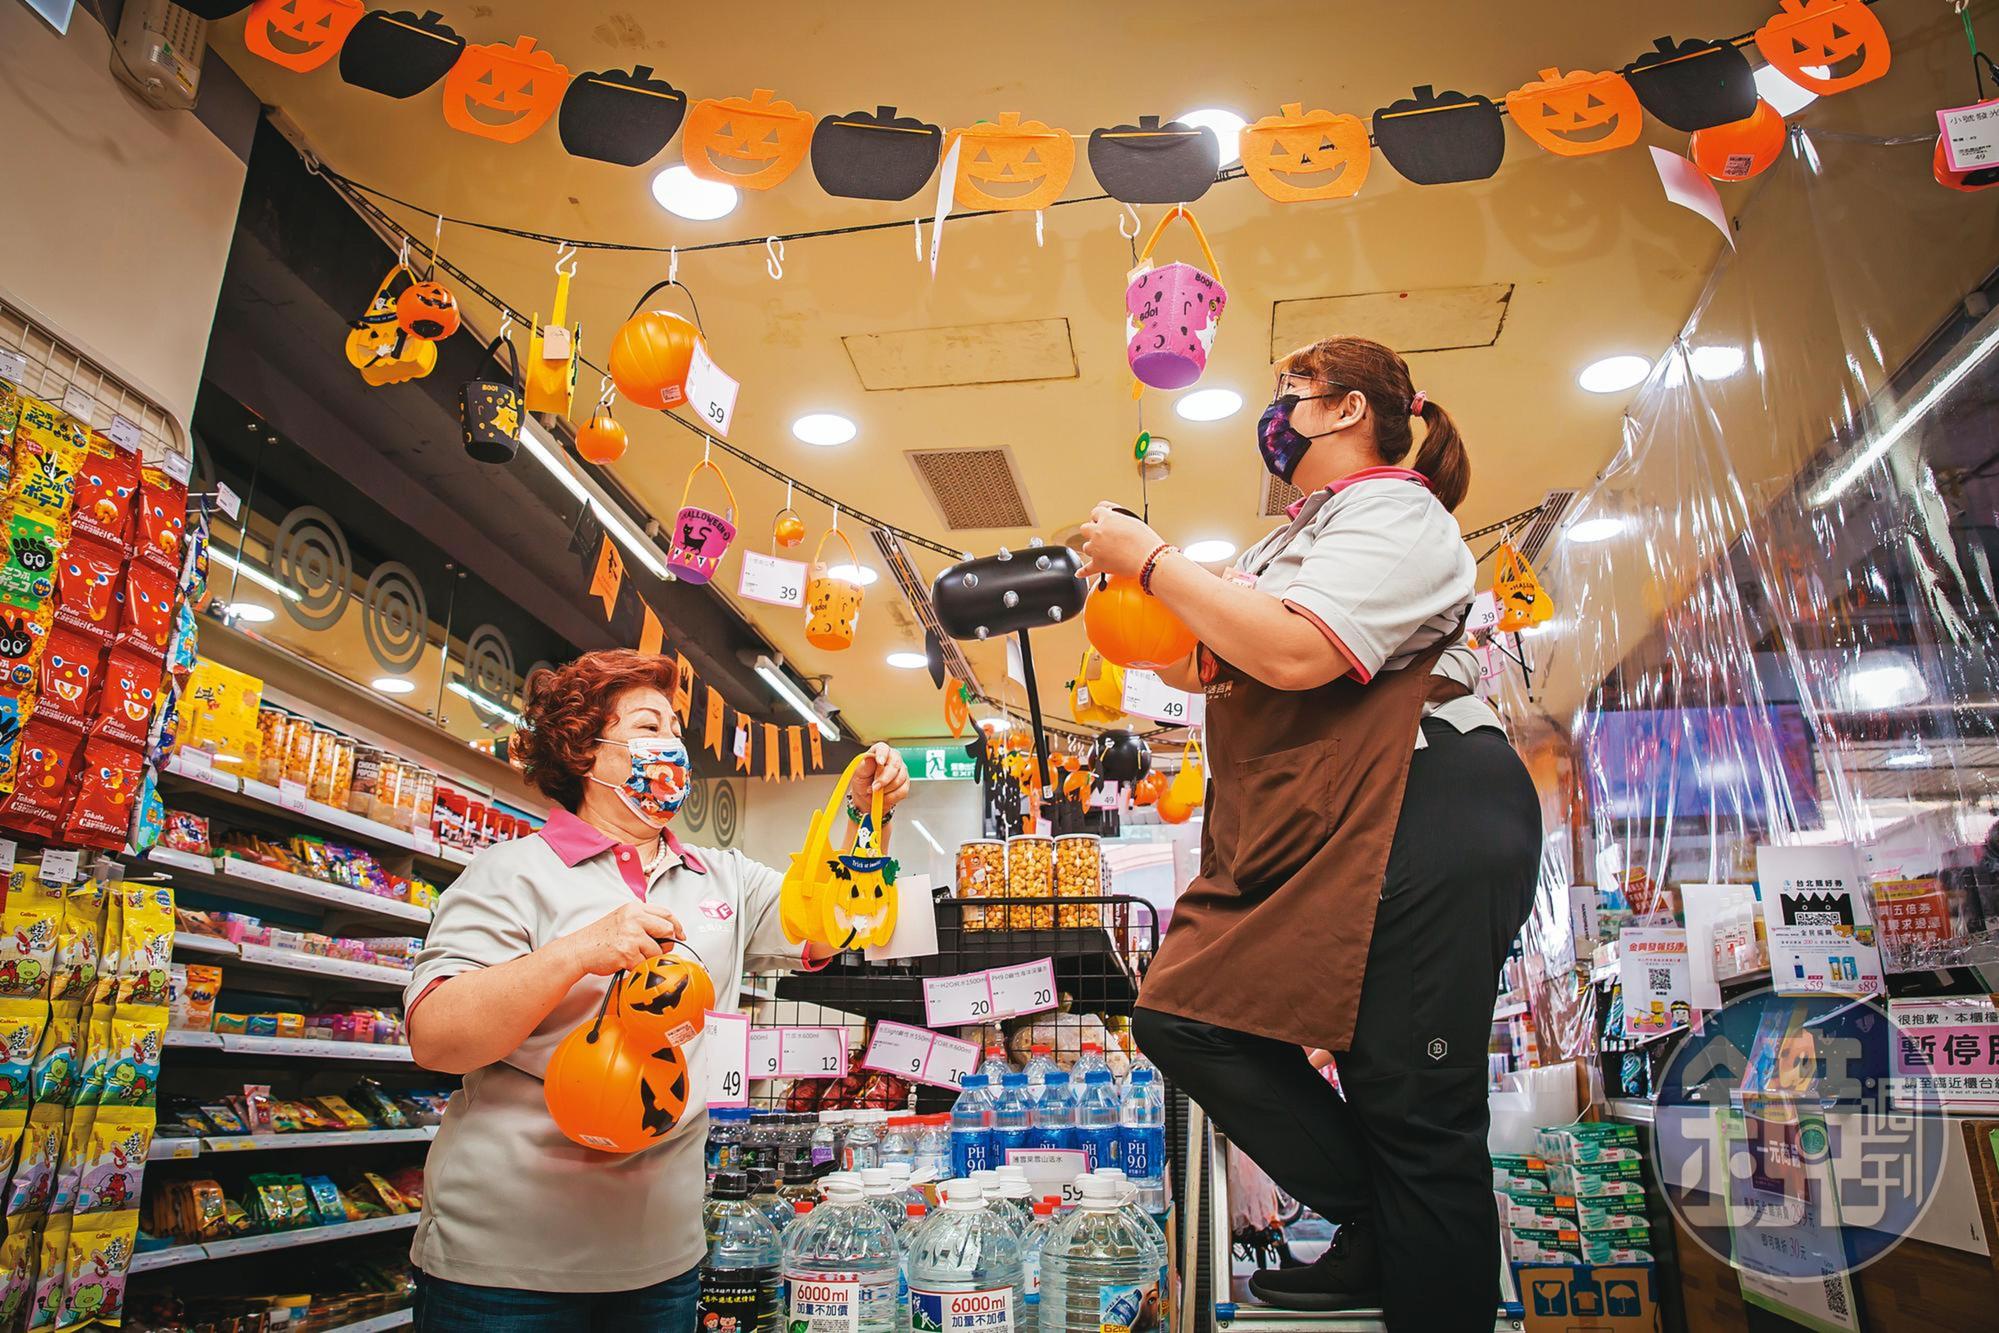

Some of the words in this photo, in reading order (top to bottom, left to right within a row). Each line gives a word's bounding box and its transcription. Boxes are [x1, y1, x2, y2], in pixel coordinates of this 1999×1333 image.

[1194, 272, 1213, 289] BOO!
[708, 401, 725, 424] 59
[780, 586, 798, 600] 39
[1481, 612, 1495, 624] 39
[1163, 702, 1183, 717] 49
[1804, 981, 1824, 992] $59
[1858, 981, 1878, 992] $89
[192, 990, 211, 1000] DHA
[1034, 988, 1051, 1005] 20
[971, 1000, 989, 1015] 20
[1901, 1034, 1999, 1066] 暫停
[768, 1058, 777, 1072] 9
[822, 1056, 837, 1071] 12
[910, 1058, 921, 1072] 9
[723, 1071, 741, 1097] 49
[949, 1069, 967, 1085] 10
[968, 1146, 985, 1159] PH
[1082, 1143, 1097, 1156] PH
[1128, 1142, 1146, 1156] PH
[1127, 1155, 1147, 1170] 9.0
[797, 1284, 848, 1302] 6000ml
[797, 1303, 848, 1316] 加量不加價
[951, 1295, 1006, 1313] 6000ml
[951, 1313, 1007, 1328] 加量不加價
